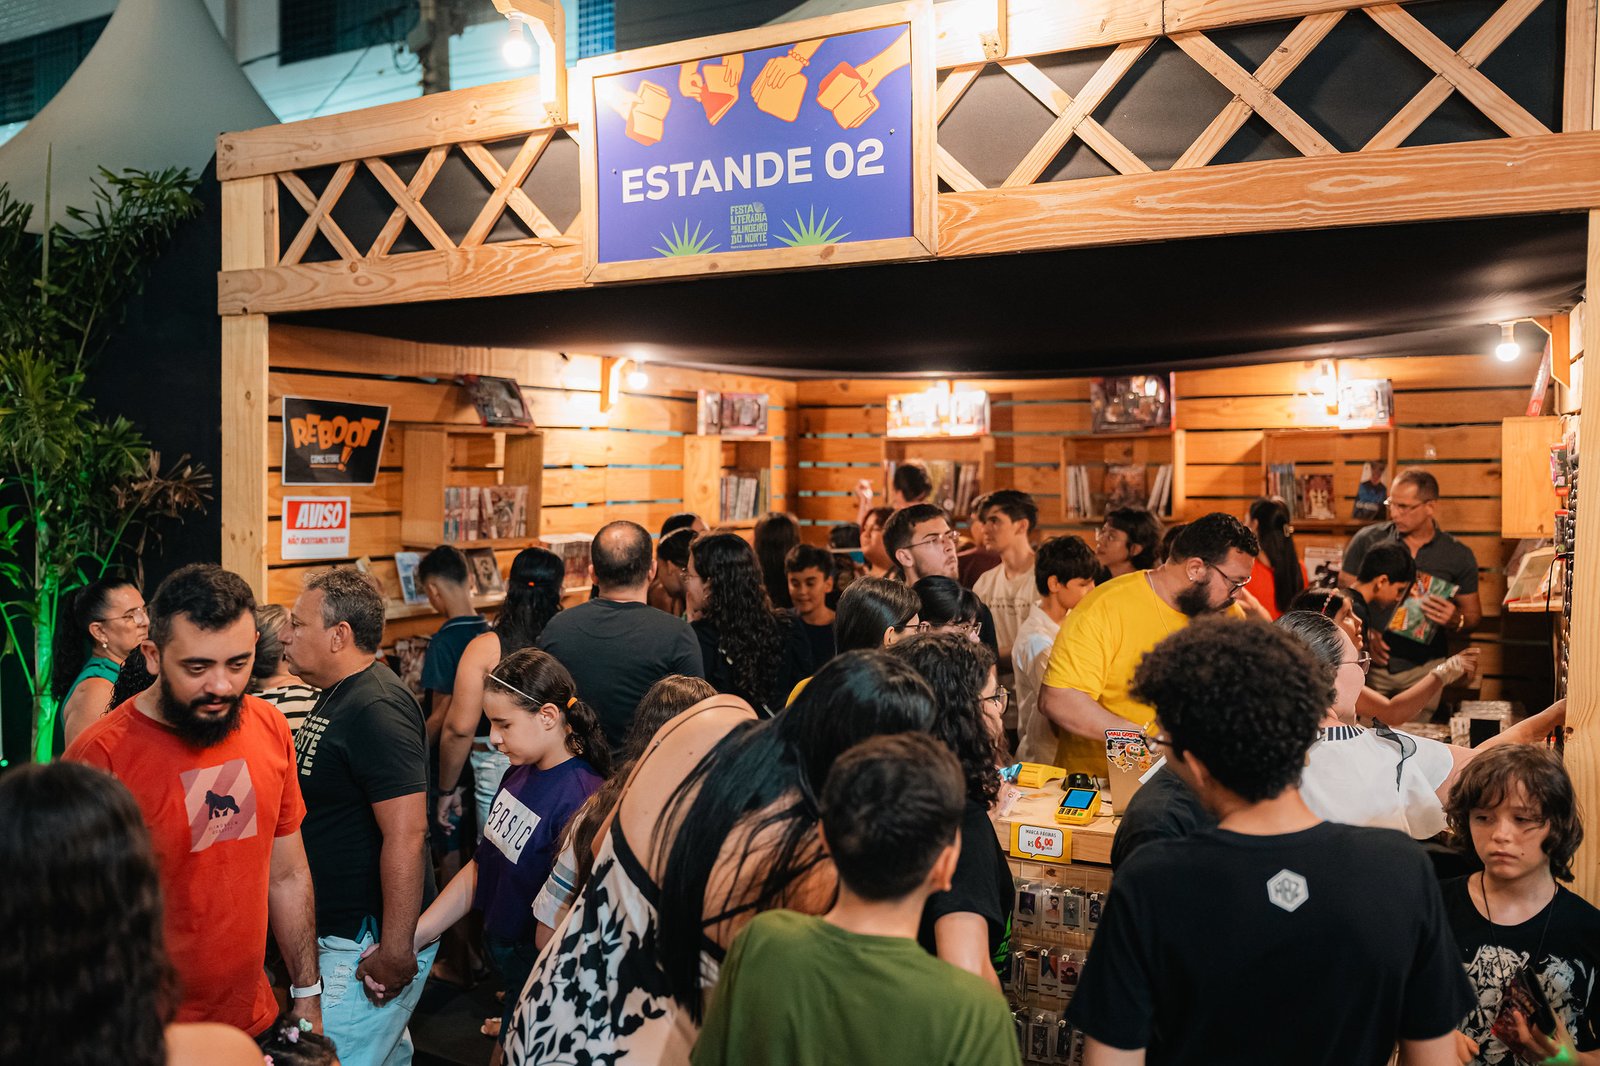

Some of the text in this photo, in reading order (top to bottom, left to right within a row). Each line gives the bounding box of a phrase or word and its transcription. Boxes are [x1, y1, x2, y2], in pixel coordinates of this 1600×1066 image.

[621, 138, 885, 204] ESTANDE 02
[730, 204, 754, 215] FESTA
[730, 232, 767, 245] DO NORTE
[295, 502, 343, 529] AVISO
[488, 801, 532, 851] BASIC
[1034, 836, 1054, 851] 6,00
